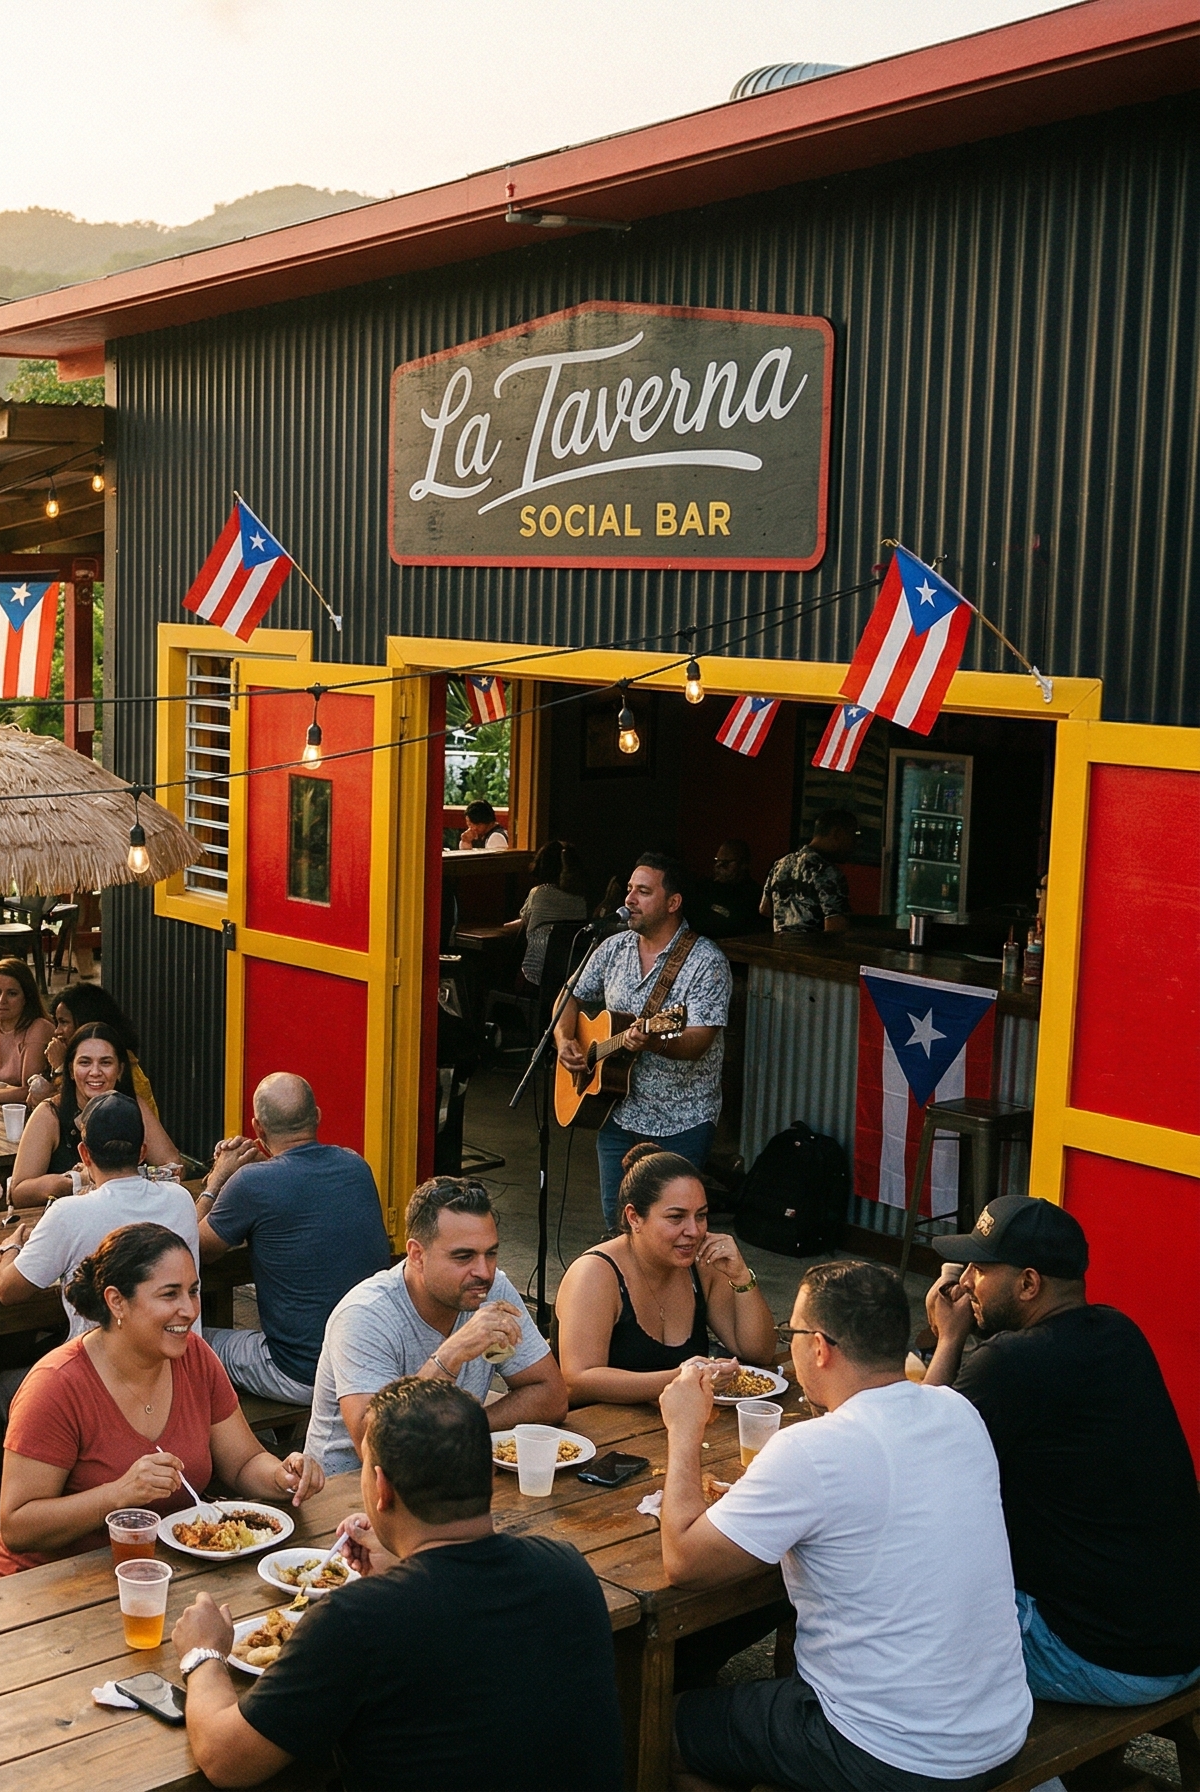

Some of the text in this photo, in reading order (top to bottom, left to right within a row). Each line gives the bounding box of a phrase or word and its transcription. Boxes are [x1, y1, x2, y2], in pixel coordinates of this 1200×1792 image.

[409, 331, 808, 501] La Taverna
[519, 501, 731, 537] SOCIAL BAR
